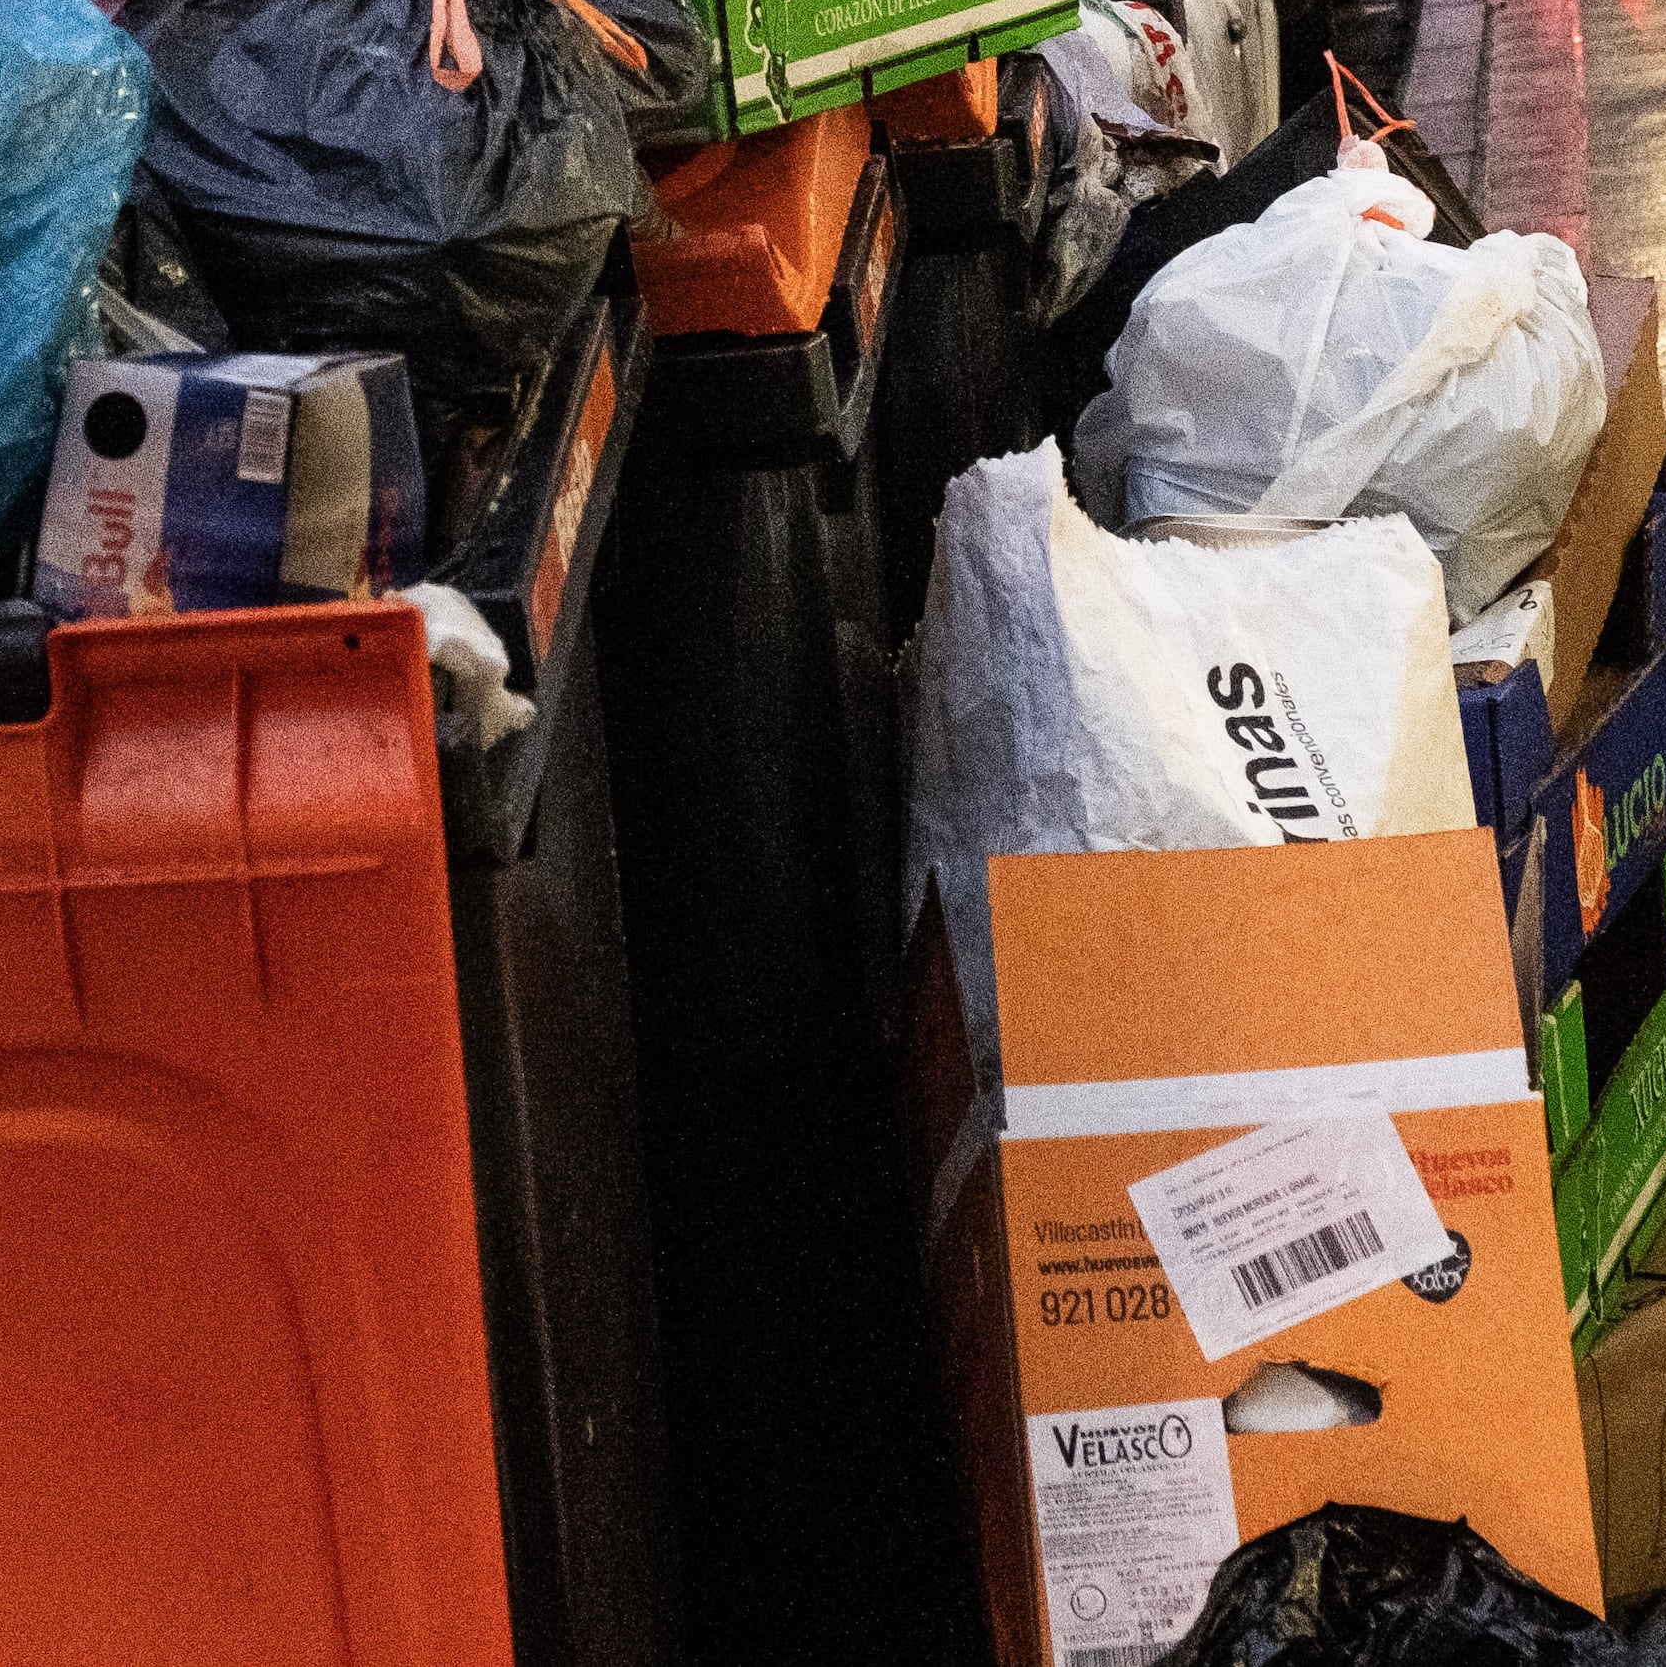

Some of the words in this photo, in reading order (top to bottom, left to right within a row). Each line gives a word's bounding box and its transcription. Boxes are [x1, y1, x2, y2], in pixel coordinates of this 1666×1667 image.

[83, 487, 136, 588] Bull
[1270, 670, 1346, 809] convencionales
[1603, 752, 1666, 873] LUCIO
[1040, 1287, 1096, 1326] 921
[1105, 1281, 1171, 1323] 028
[1052, 1414, 1192, 1469] VELASCO
